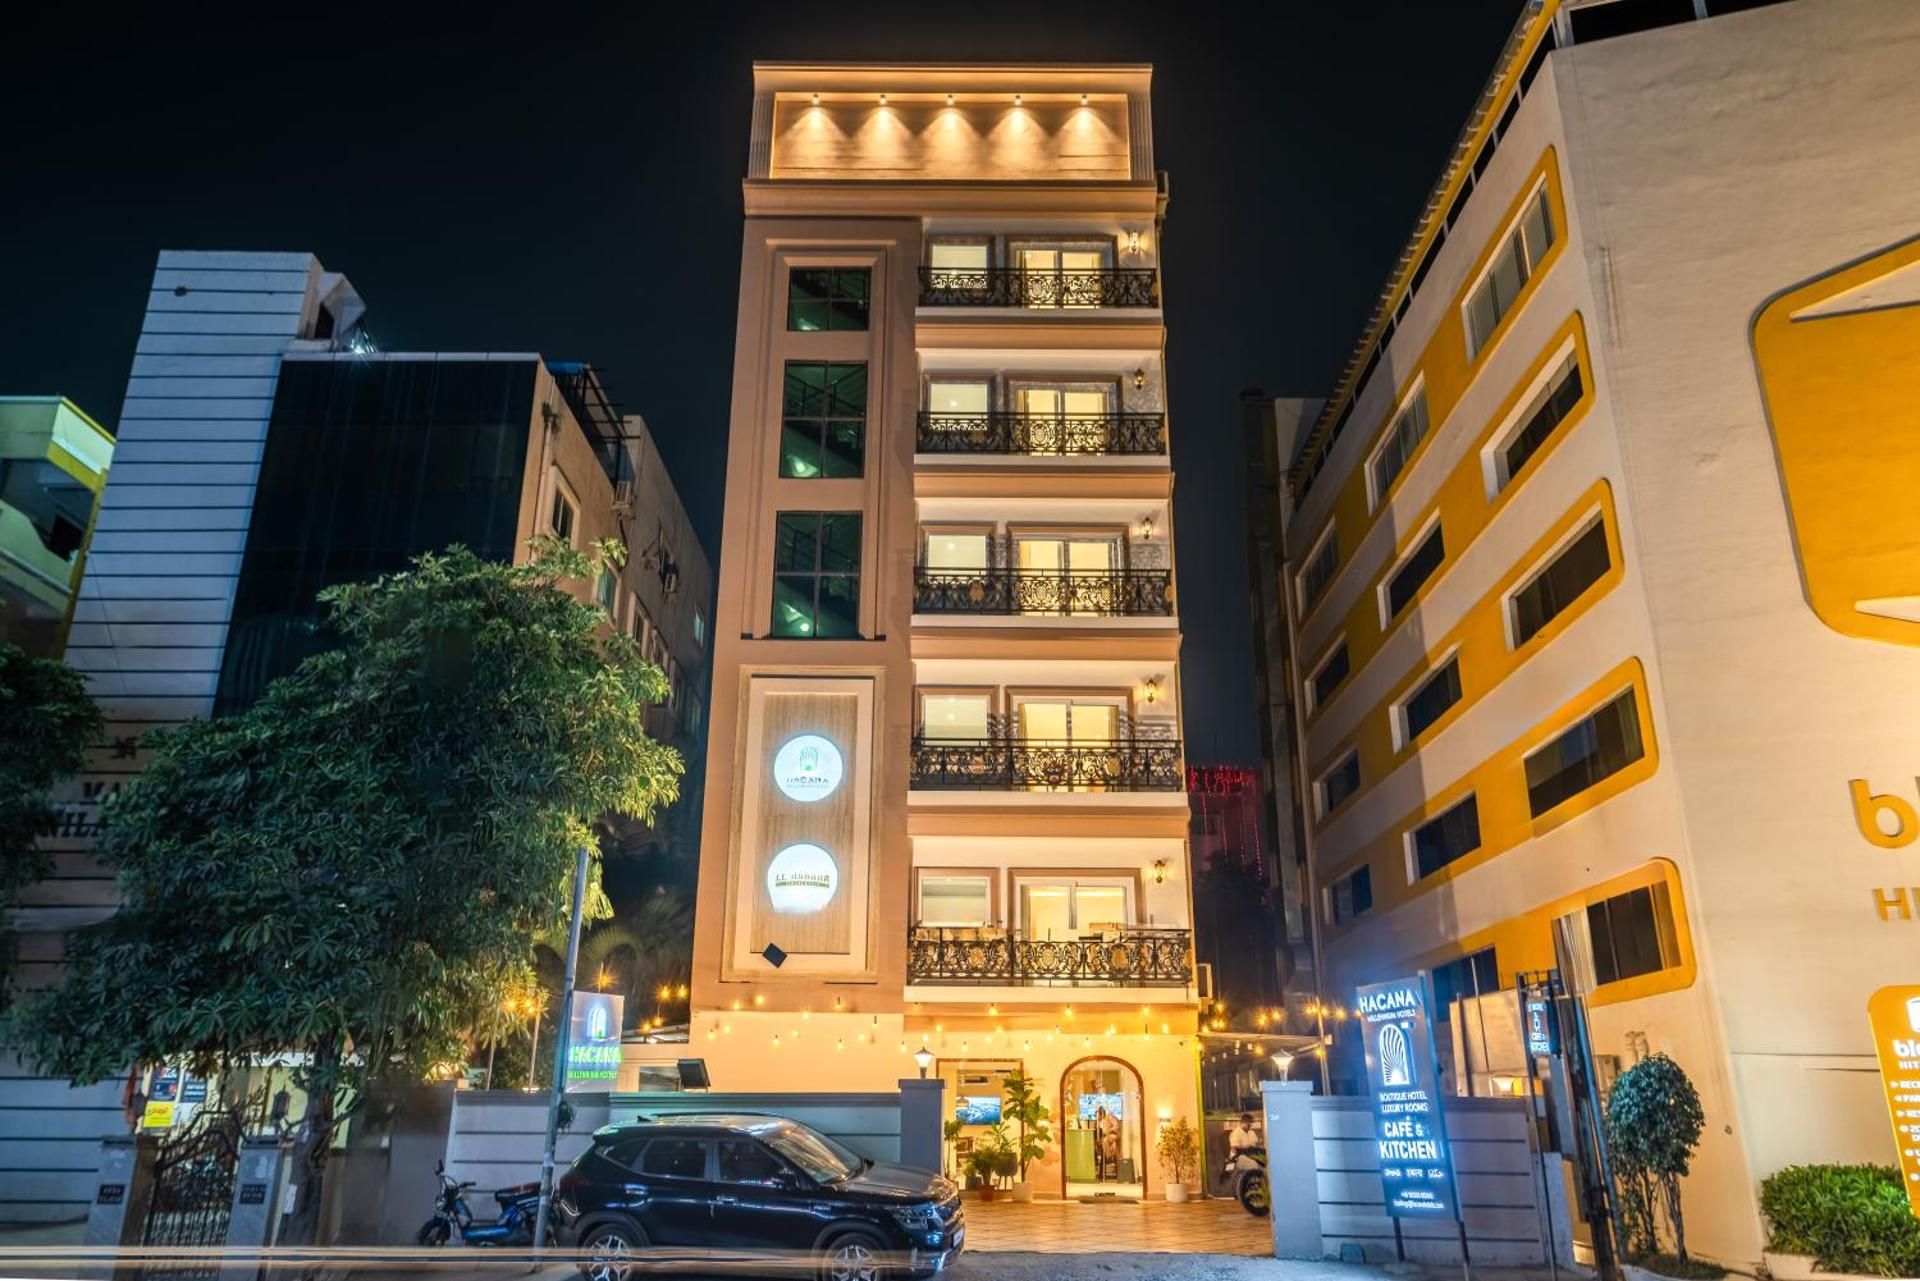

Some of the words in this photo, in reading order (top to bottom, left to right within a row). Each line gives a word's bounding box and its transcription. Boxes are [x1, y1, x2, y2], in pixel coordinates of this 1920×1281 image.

[1360, 989, 1416, 1013] HACANA
[1407, 1091, 1427, 1100] HOTEL
[1382, 1103, 1404, 1113] LUXURY
[1405, 1102, 1429, 1112] ROOMS
[1384, 1116, 1413, 1138] CAFÉ
[1415, 1123, 1424, 1137] &
[1379, 1140, 1437, 1159] KITCHEN
